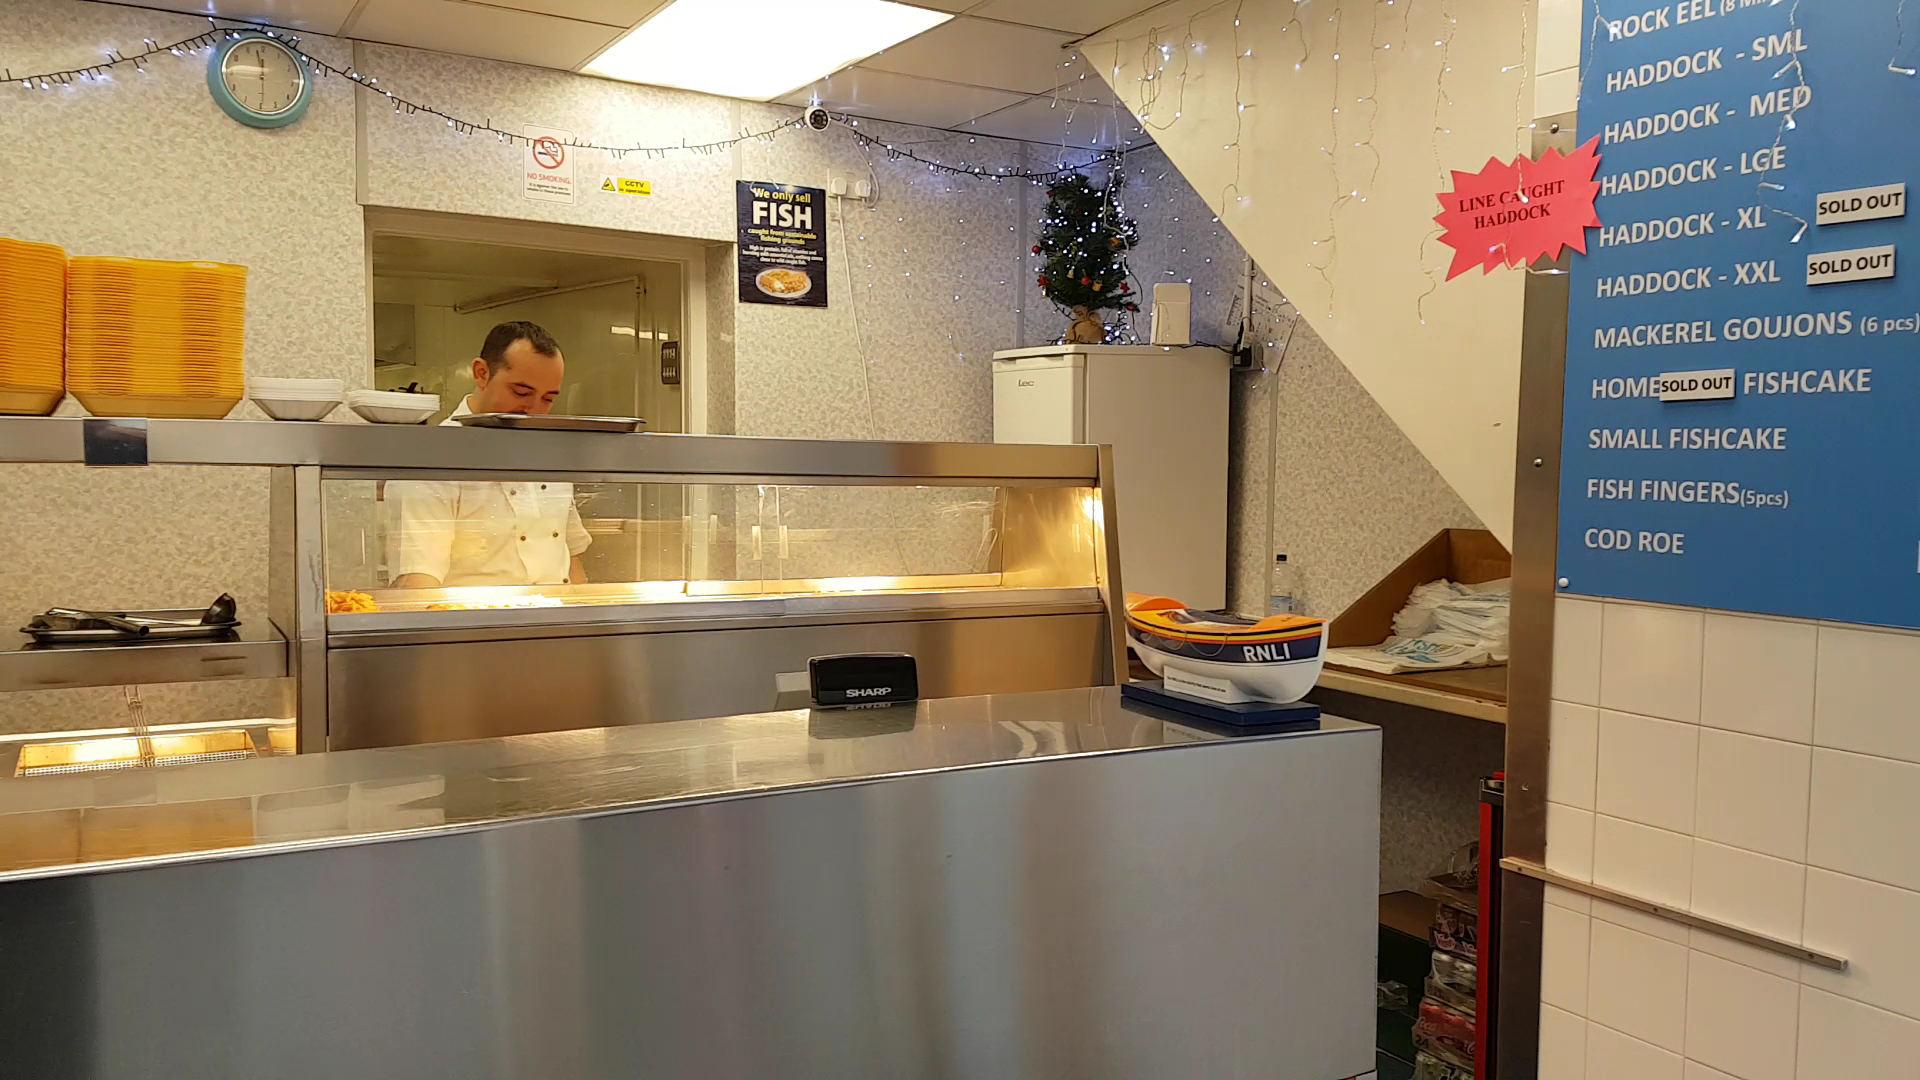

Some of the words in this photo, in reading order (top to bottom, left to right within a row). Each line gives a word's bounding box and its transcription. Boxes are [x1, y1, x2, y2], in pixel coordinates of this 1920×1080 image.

[1608, 6, 1670, 42] ROCK
[1676, 0, 1716, 25] EEL
[1606, 48, 1723, 93] HADDOCK
[1752, 28, 1808, 61] SML
[1604, 103, 1721, 145] HADDOCK
[1749, 85, 1812, 118] MED
[526, 172, 537, 180] NO
[625, 180, 645, 188] CCTV
[1601, 158, 1717, 197] HADDOCK
[1740, 146, 1787, 175] LGE
[753, 187, 770, 199] We
[772, 191, 794, 204] only
[795, 193, 811, 203] sell
[1459, 194, 1496, 213] LINE
[1499, 180, 1565, 204] CAUGHT
[1818, 197, 1862, 216] SOLD
[1866, 192, 1903, 210] OUT
[752, 200, 813, 230] FISH
[1474, 203, 1551, 229] HADDOCK
[1600, 212, 1715, 248] HADDOCK
[1736, 205, 1767, 230] XL
[1809, 259, 1852, 276] SOLD
[1856, 254, 1892, 272] OUT
[1597, 267, 1712, 298] HADDOCK
[1733, 260, 1781, 286] XXL
[1594, 320, 1716, 348] MACKEREL
[1723, 311, 1852, 341] GOUJONS
[1861, 316, 1878, 337] (6
[1883, 312, 1920, 336] pcs)
[1661, 378, 1698, 393] SOLD
[1701, 376, 1732, 391] OUT
[1743, 368, 1872, 395] FISHCAKE
[1588, 428, 1662, 450] SMALL
[1669, 427, 1788, 450] FISHCAKE
[1587, 478, 1633, 500] FISH
[1584, 527, 1631, 550] COD
[1638, 531, 1685, 555] ROE
[1242, 642, 1291, 663] RNLI
[846, 687, 892, 698] SHARP
